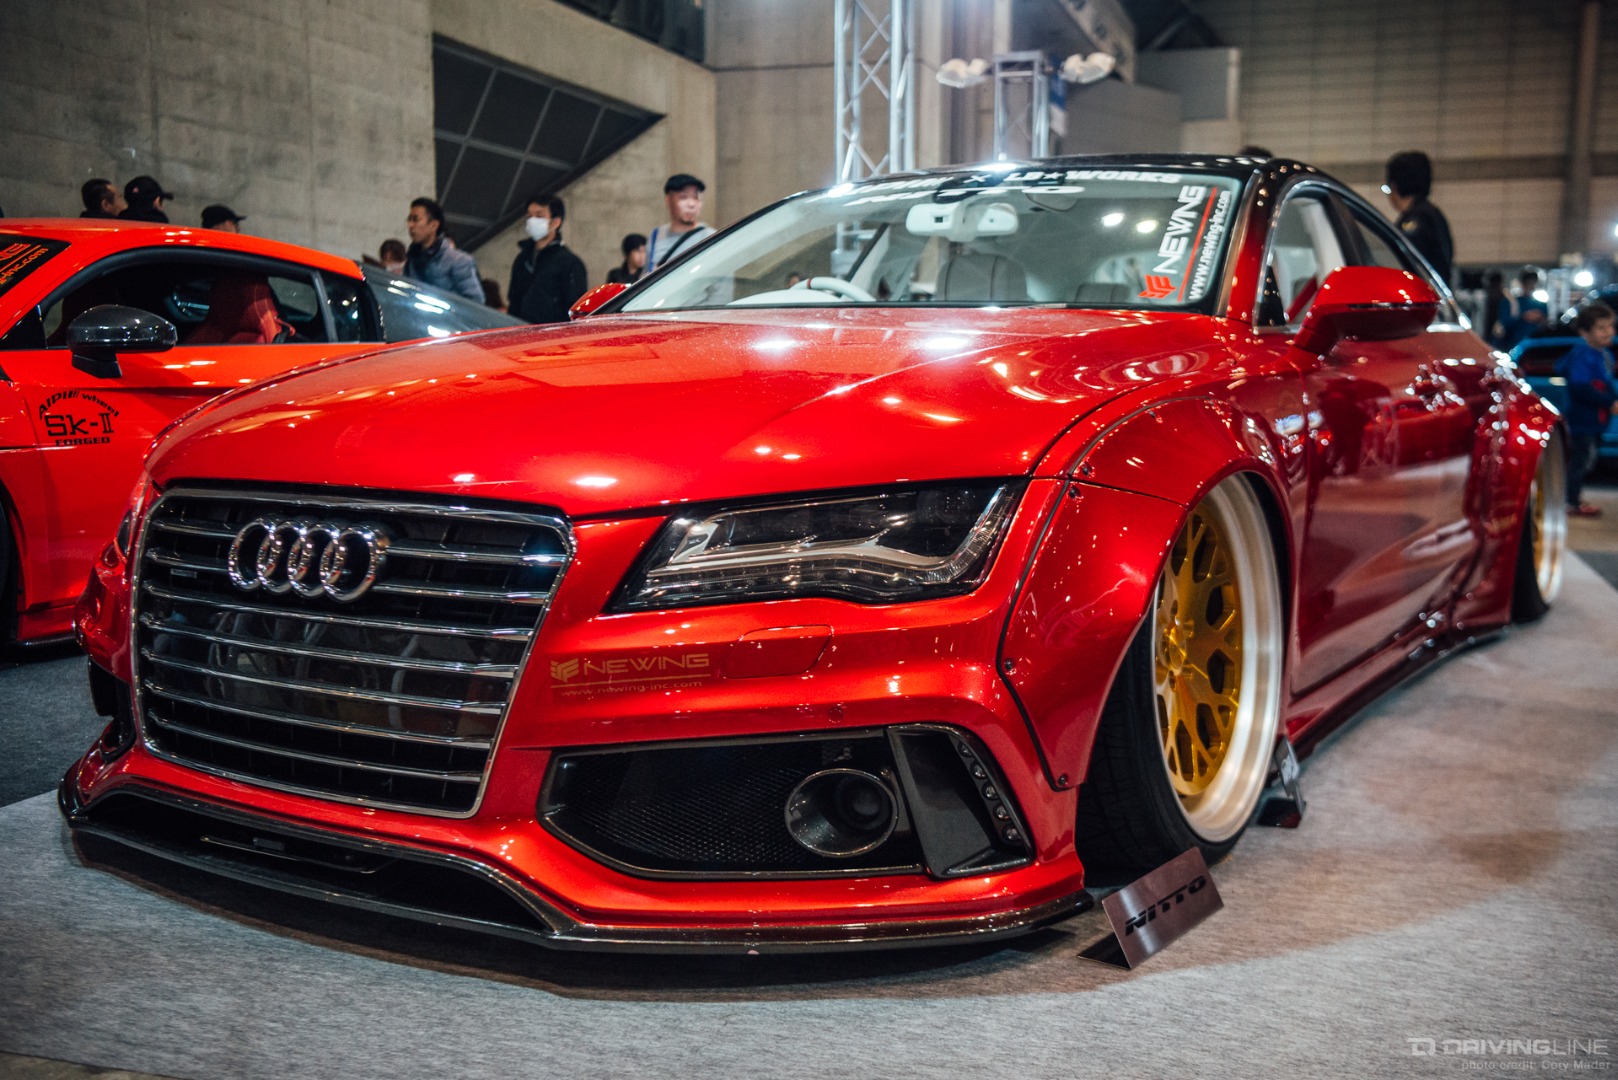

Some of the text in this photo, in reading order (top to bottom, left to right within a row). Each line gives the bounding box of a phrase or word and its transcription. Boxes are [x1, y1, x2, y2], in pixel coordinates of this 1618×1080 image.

[1153, 185, 1207, 274] NEWING
[1188, 190, 1232, 300] www.newing-inc.com
[82, 393, 119, 418] wheel
[55, 436, 111, 447] FORGED
[583, 653, 710, 675] NEWING
[560, 679, 703, 697] www.newing-inc.com
[1125, 875, 1207, 936] NITTO
